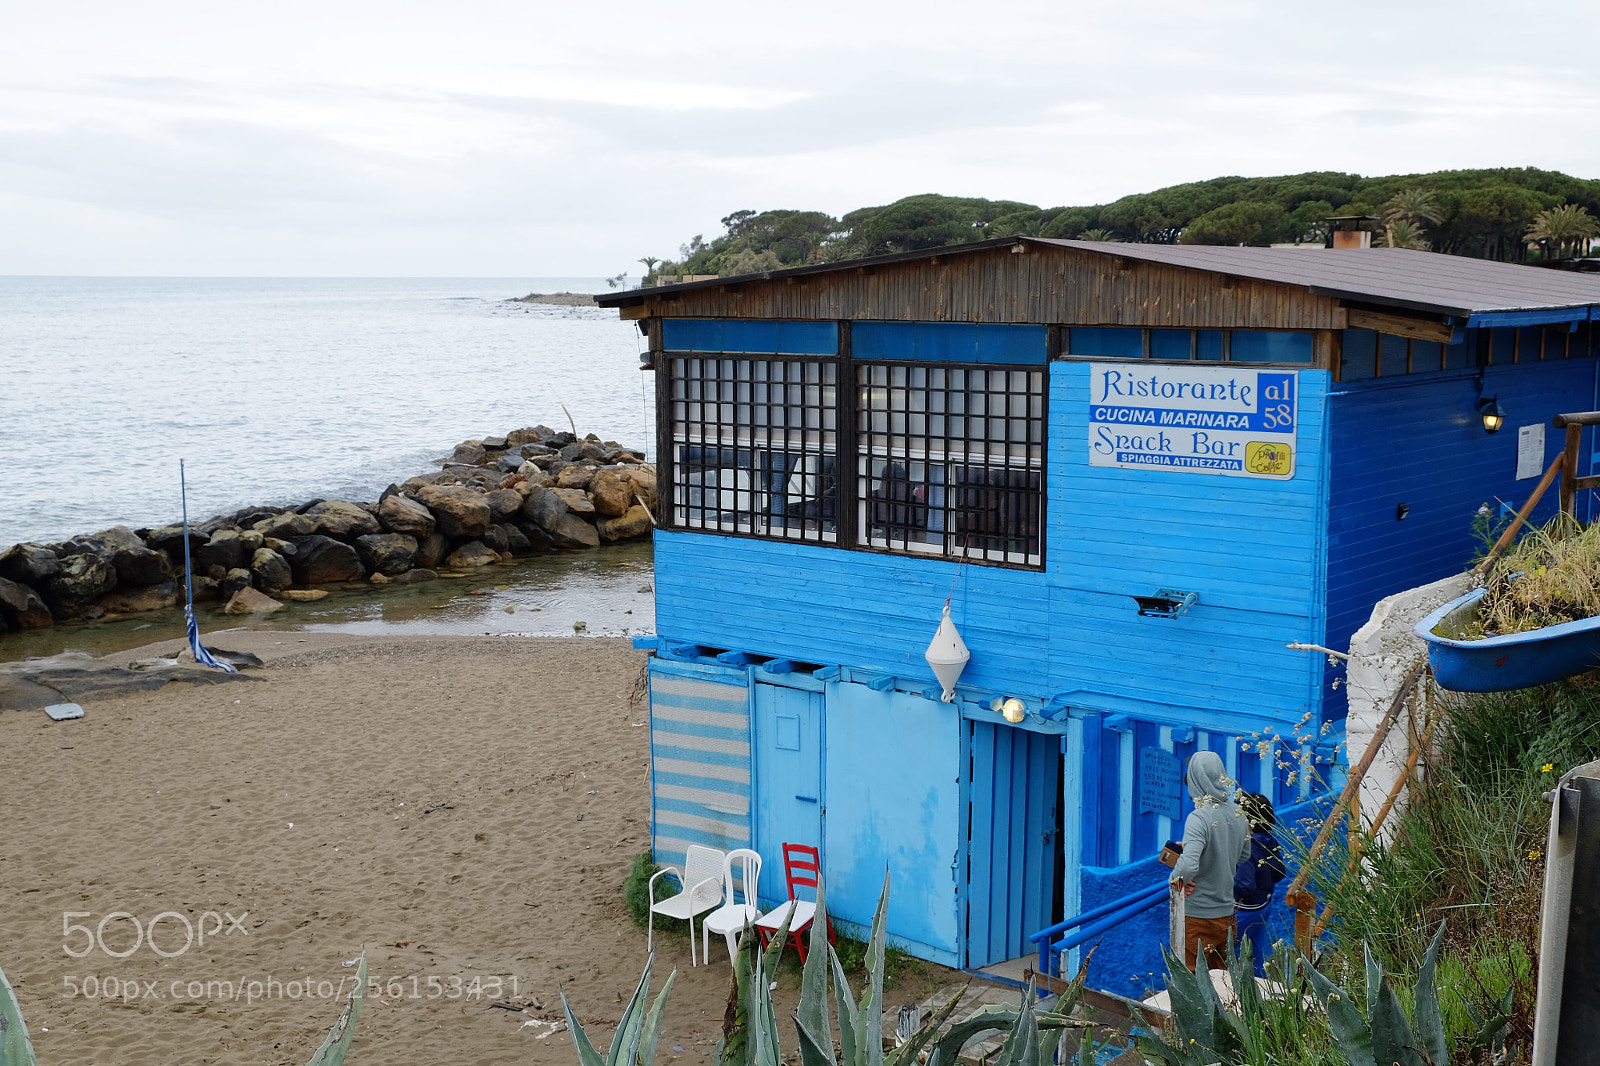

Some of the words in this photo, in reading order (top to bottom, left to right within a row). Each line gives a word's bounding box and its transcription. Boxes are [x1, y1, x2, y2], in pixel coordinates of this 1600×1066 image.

[1100, 369, 1252, 407] Ristorante
[1264, 378, 1291, 401] al
[1095, 407, 1156, 424] CUCINA
[1159, 411, 1250, 429] MARINARA
[1263, 404, 1293, 429] 58
[1094, 425, 1173, 456] Snack
[1191, 431, 1241, 457] Bar
[1121, 453, 1171, 466] SPIAGGIA
[1173, 457, 1240, 471] ATTREZZATA
